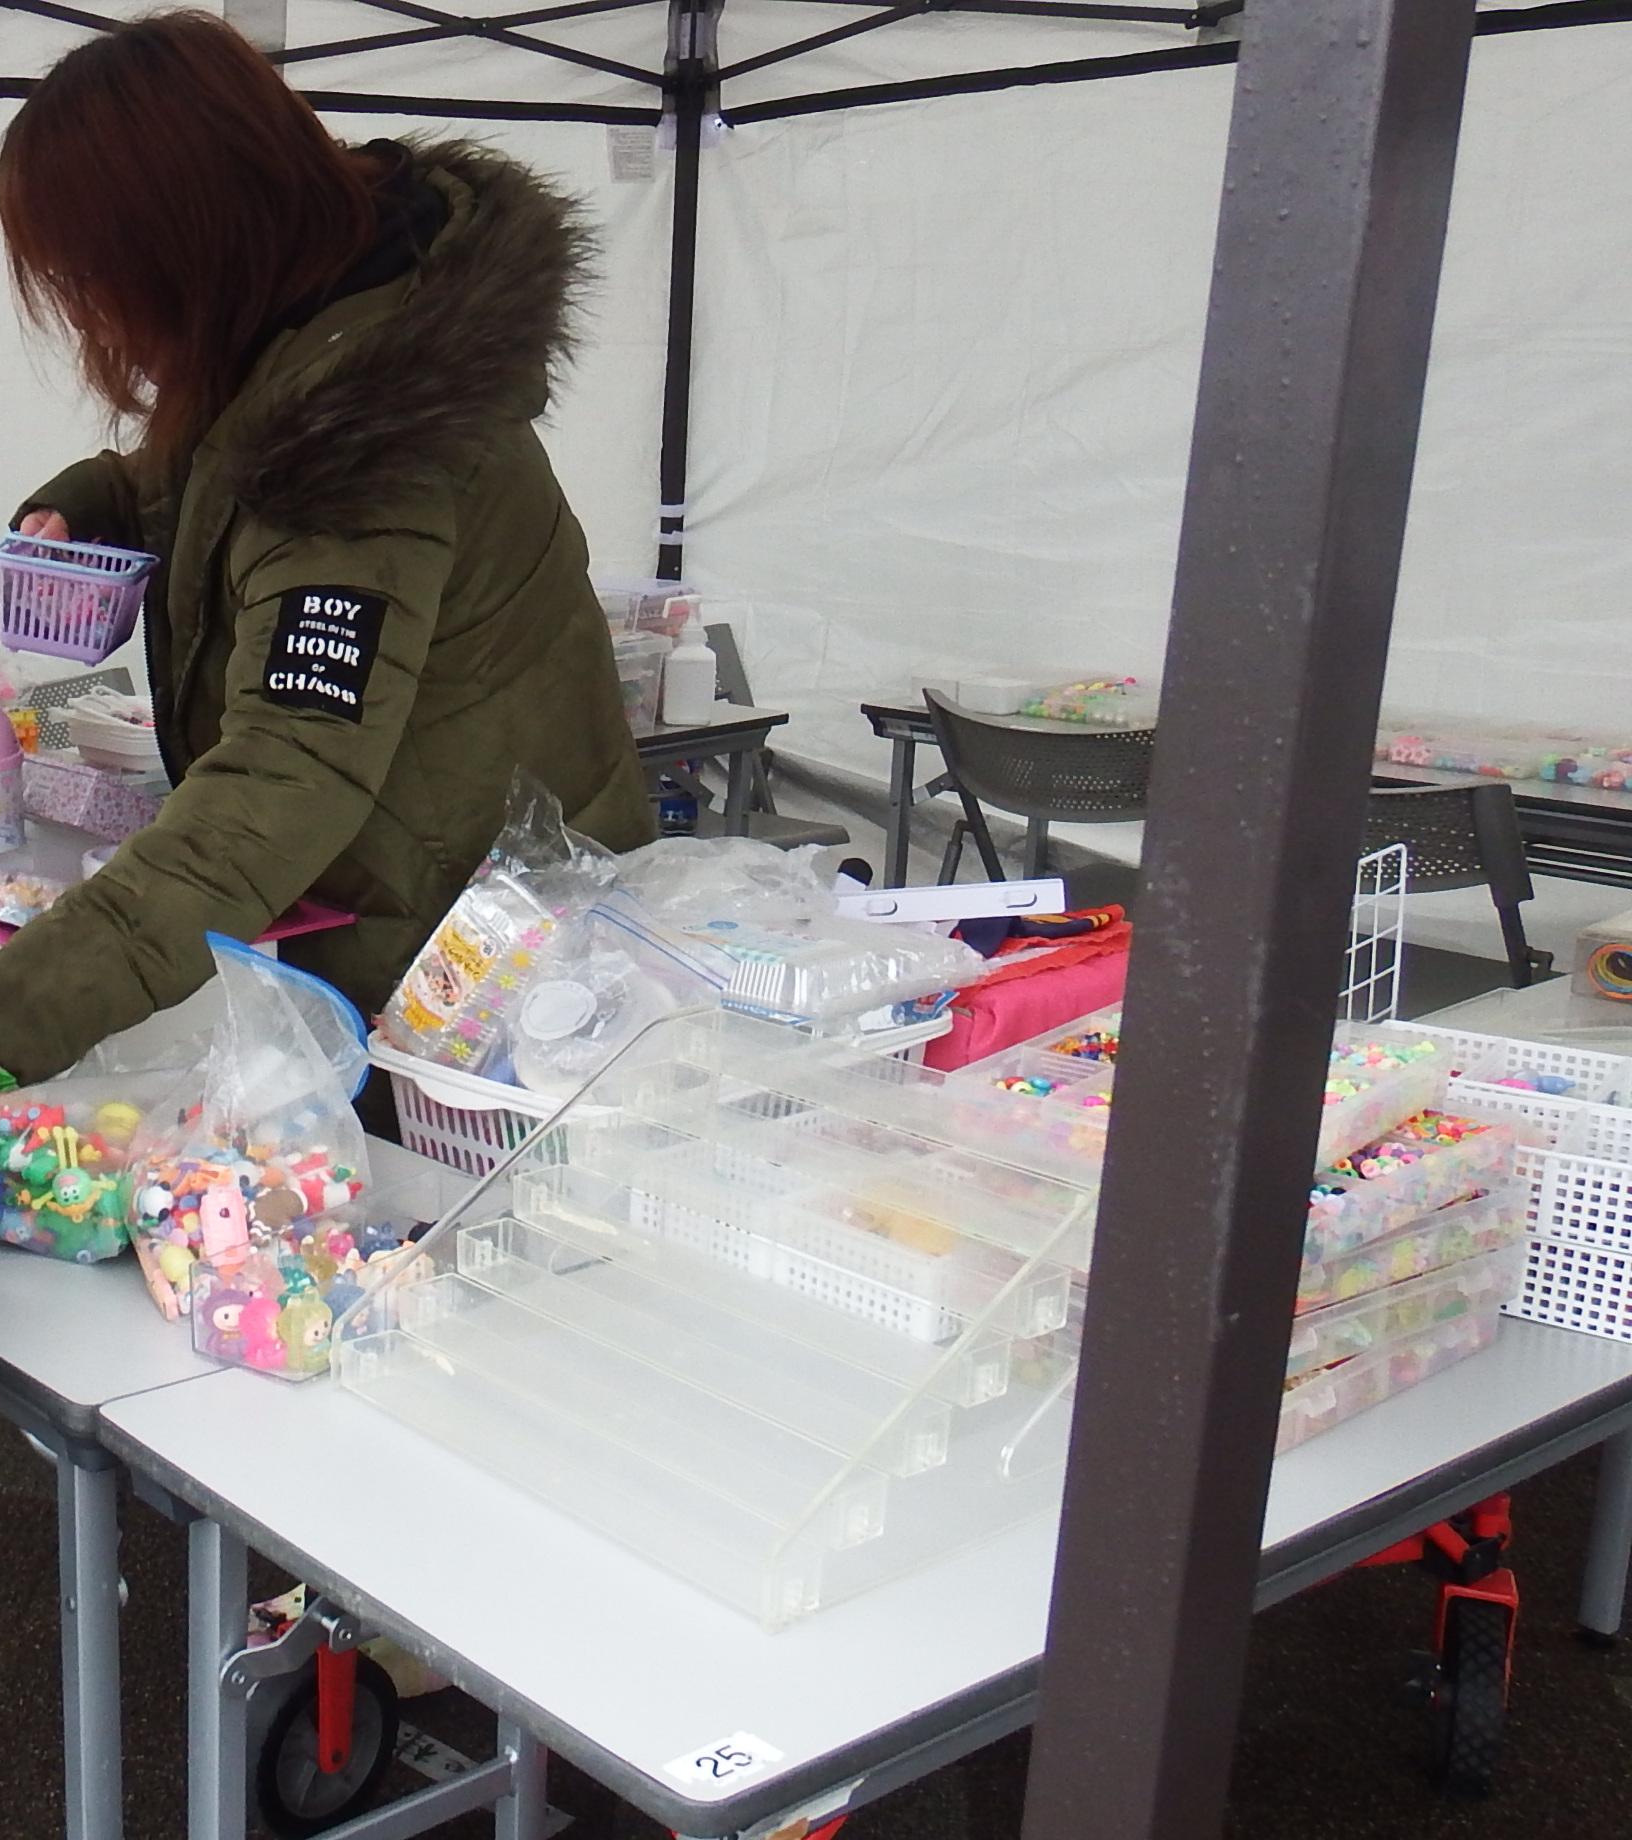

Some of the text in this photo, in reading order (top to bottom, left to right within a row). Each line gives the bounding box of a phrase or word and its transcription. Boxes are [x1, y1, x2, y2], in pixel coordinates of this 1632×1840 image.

[303, 595, 362, 621] BOY
[286, 634, 360, 667] HOUR
[269, 672, 357, 705] CHAOS
[695, 1744, 753, 1778] 25
